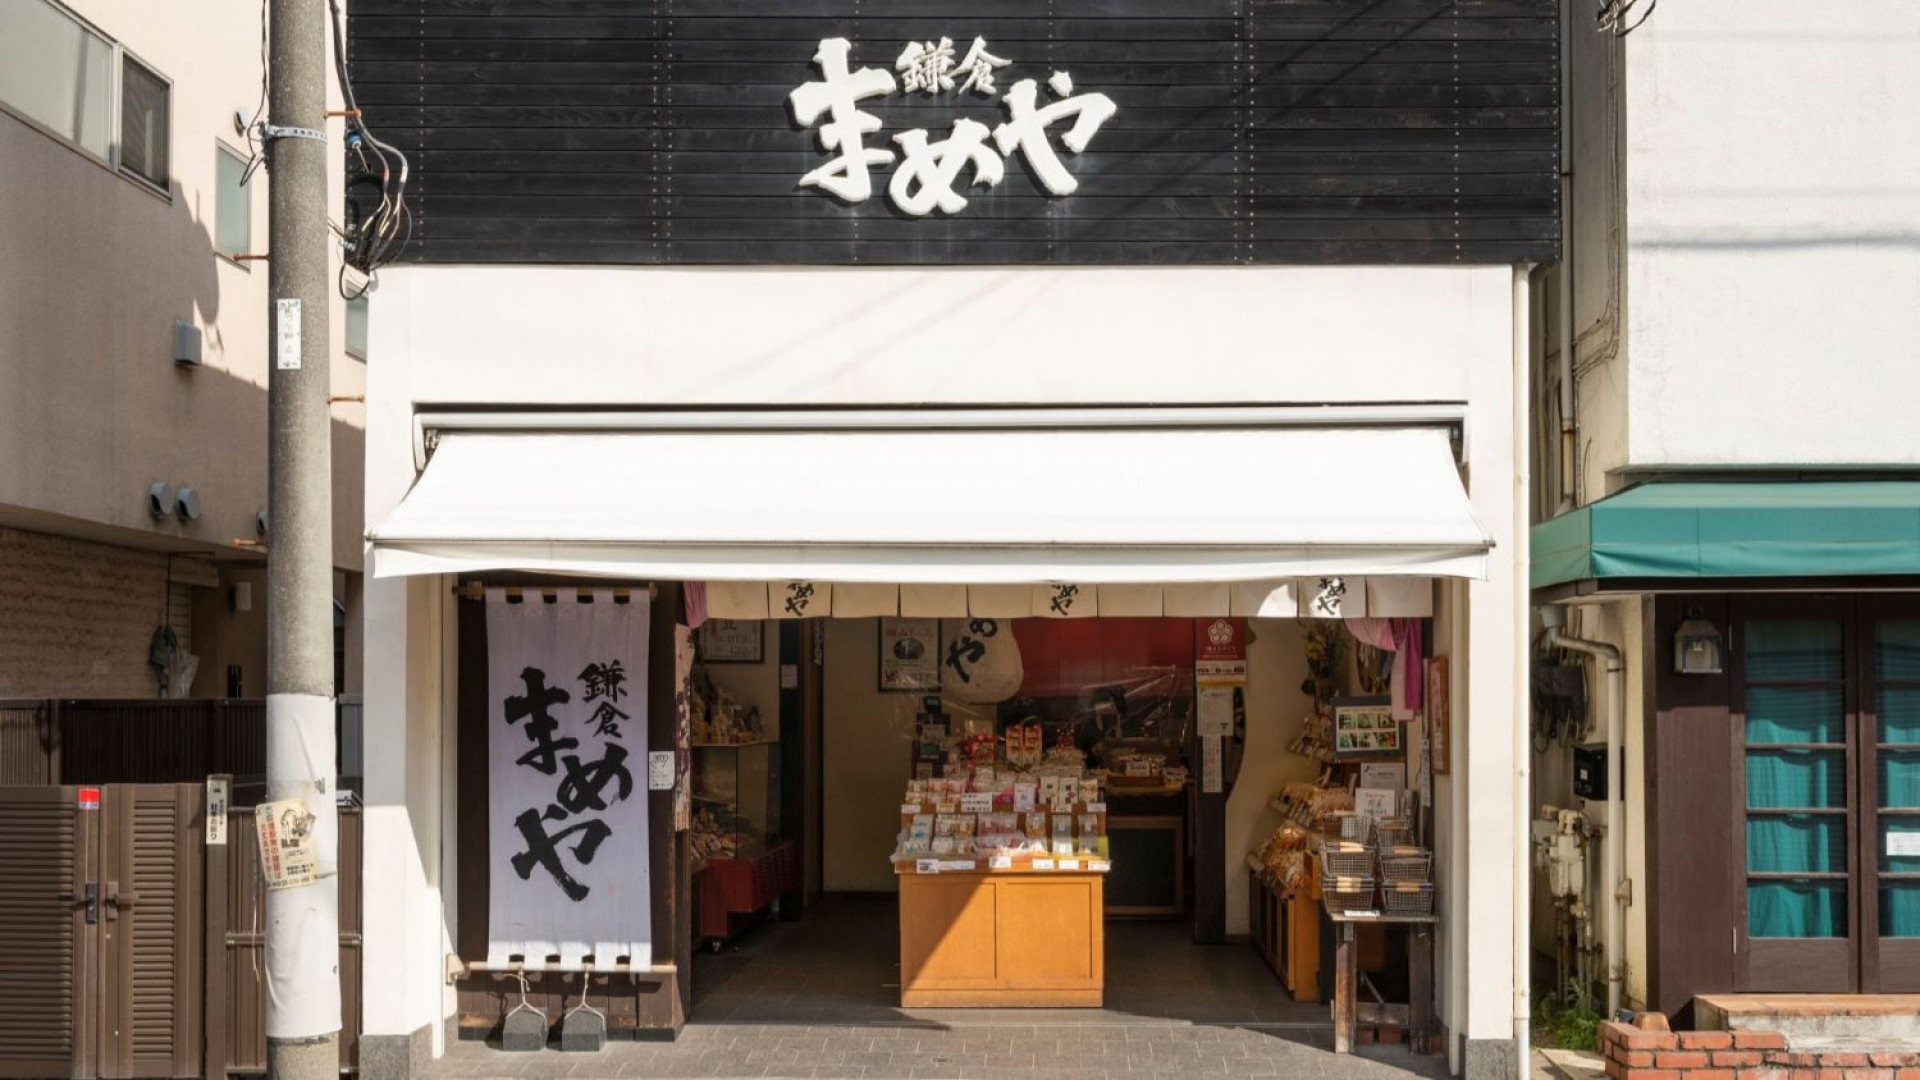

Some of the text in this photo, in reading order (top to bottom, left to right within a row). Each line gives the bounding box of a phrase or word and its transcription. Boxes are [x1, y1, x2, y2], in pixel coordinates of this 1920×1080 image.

[789, 36, 1117, 215] まめや
[895, 35, 1013, 94] 鎌倉
[577, 658, 631, 739] 鎌倉
[503, 666, 633, 901] まめや
